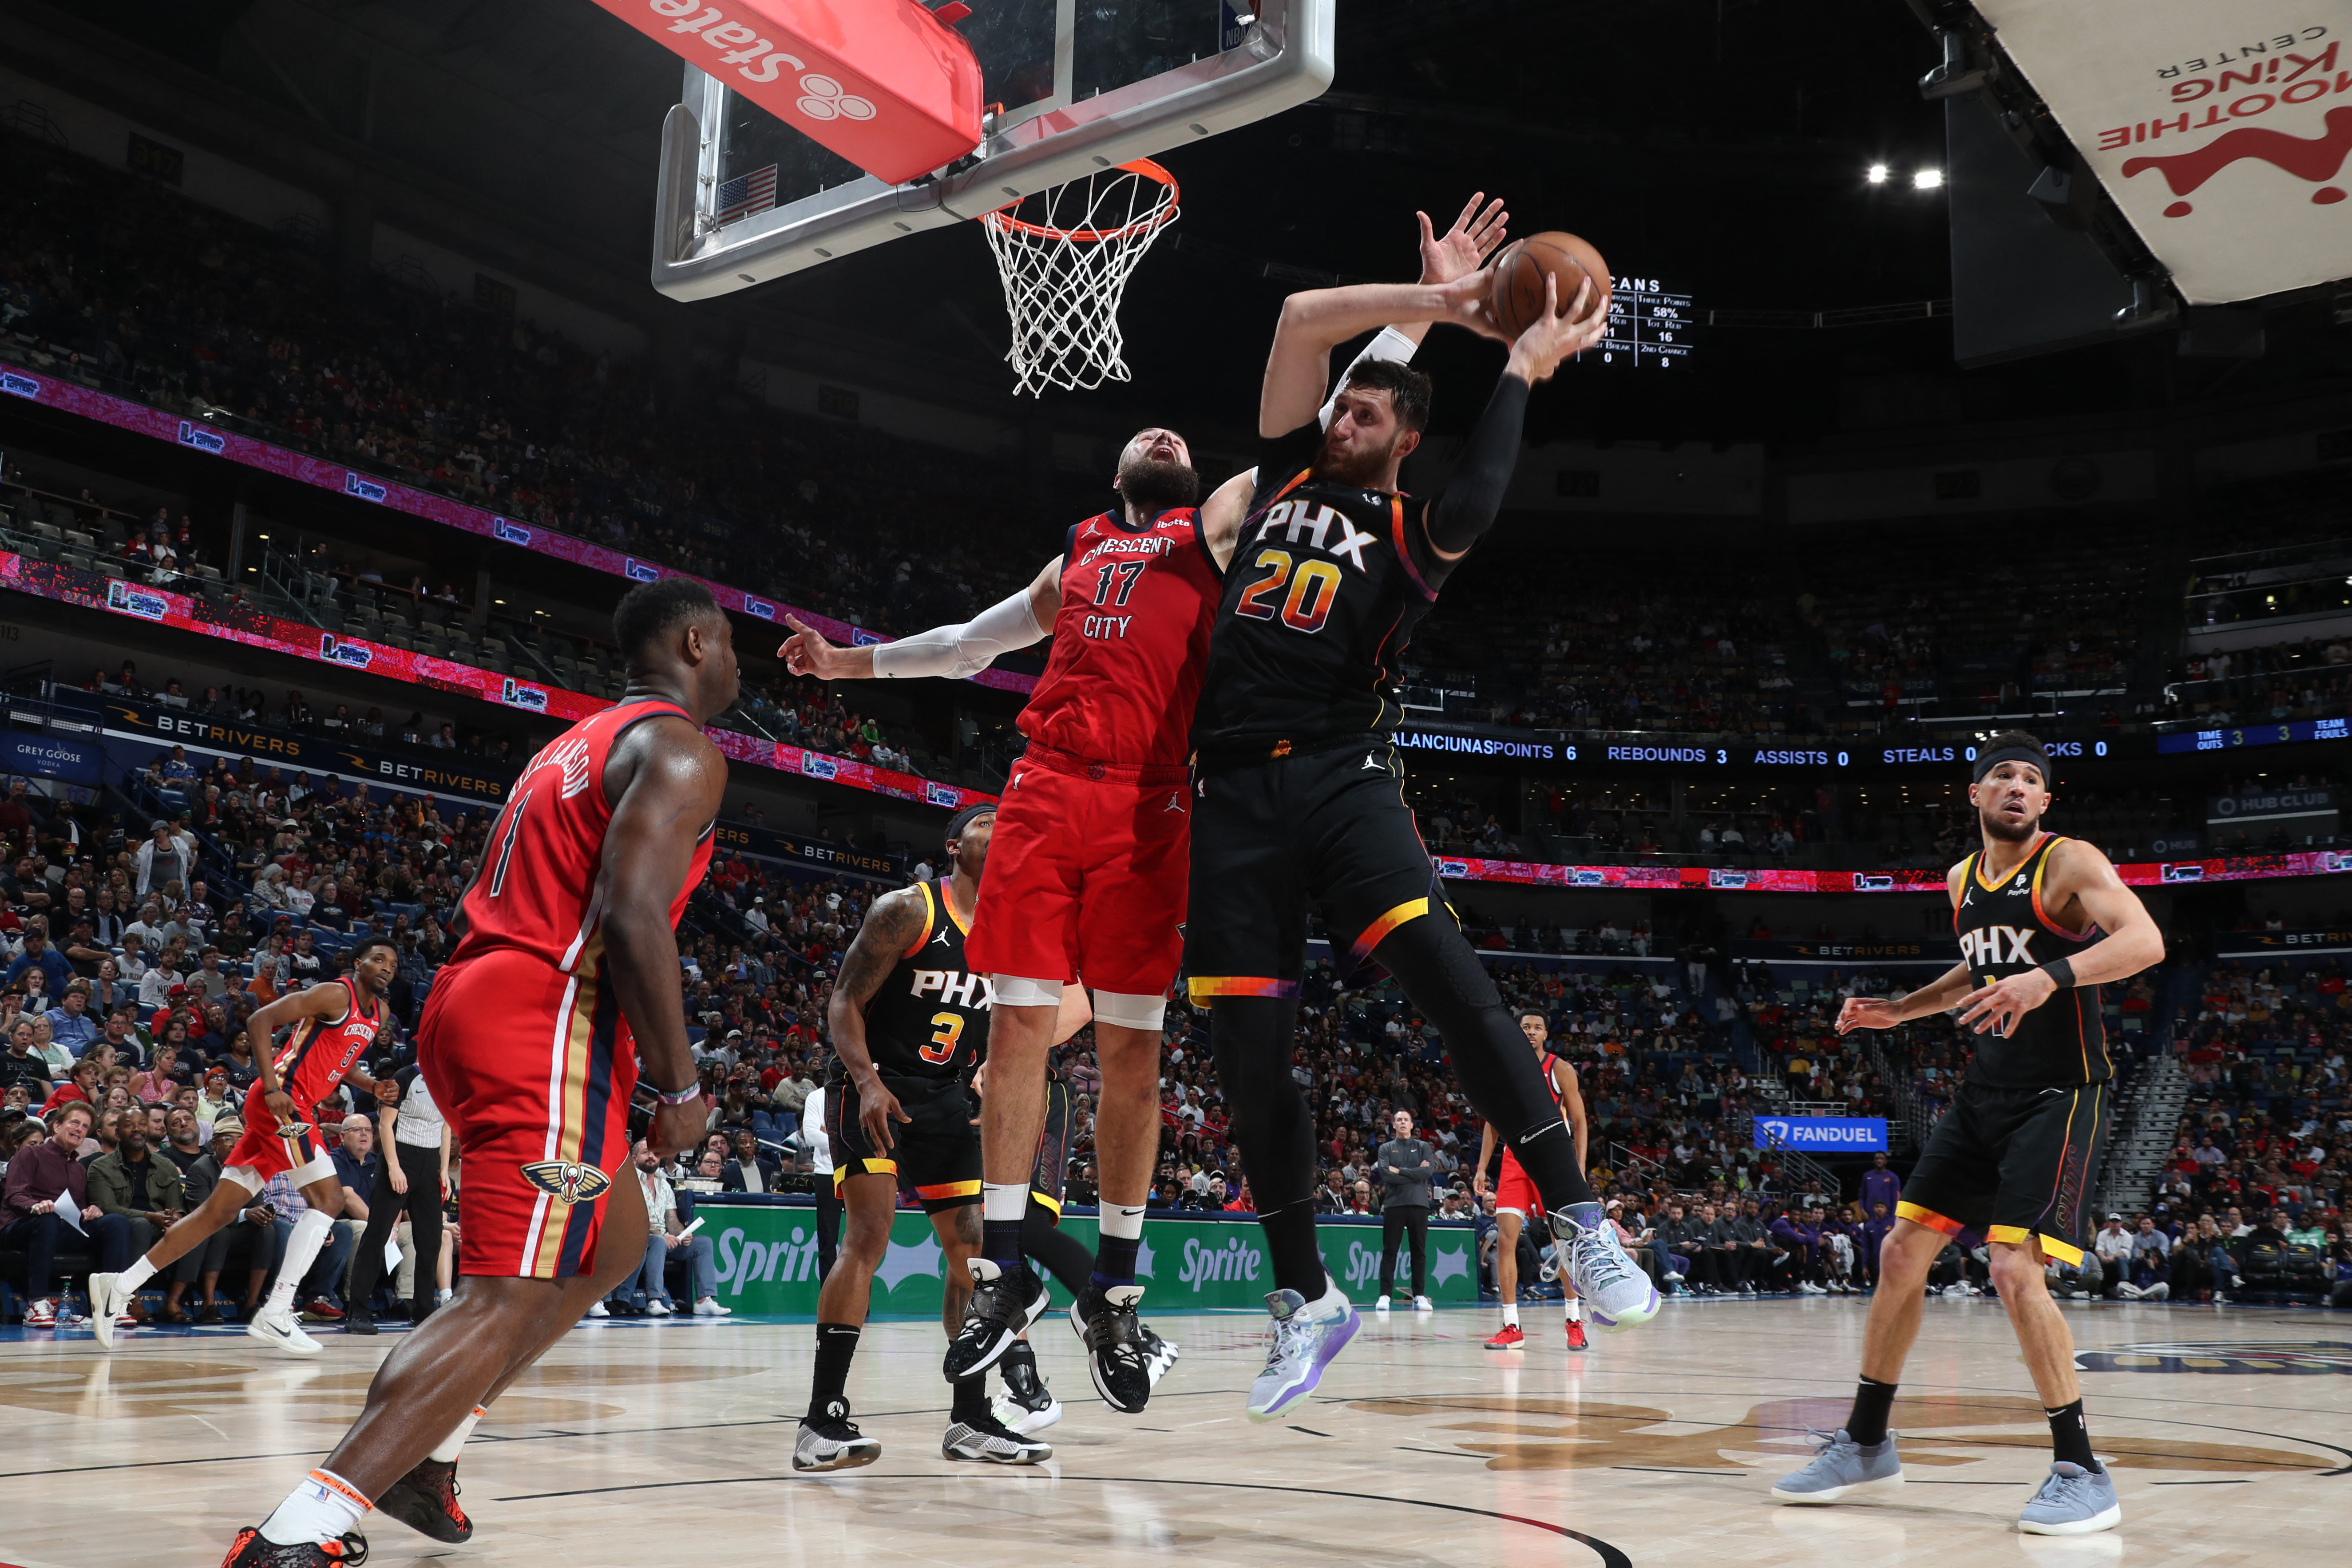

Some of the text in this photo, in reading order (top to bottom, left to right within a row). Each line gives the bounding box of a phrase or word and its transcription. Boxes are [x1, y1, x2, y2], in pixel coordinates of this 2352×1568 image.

[650, 0, 806, 83] State
[2158, 26, 2328, 79] CENTER
[1653, 307, 1678, 319] 58%
[1665, 321, 1682, 329] REB
[1659, 332, 1673, 343] 16
[1605, 341, 1631, 351] BREAK
[1604, 352, 1612, 363] 0
[1661, 357, 1670, 368] 8
[643, 501, 662, 517] 317
[704, 523, 721, 536] 318
[1157, 518, 1191, 529] ibotta
[1255, 500, 1378, 572] PHX
[1080, 536, 1176, 567] CRESCENT
[1093, 560, 1146, 606] 17
[1235, 549, 1342, 634] 20
[1084, 615, 1132, 640] CITY
[1445, 672, 1461, 682] 321
[2315, 718, 2345, 729] TEAM
[157, 715, 300, 756] BETRIVERS
[2197, 730, 2222, 740] TIME
[2233, 730, 2244, 745] 3
[2279, 725, 2291, 741] 3
[2314, 729, 2348, 740] FOULS
[1493, 741, 1553, 759] POINTS
[1567, 746, 1576, 760] 6
[2095, 742, 2107, 756] 0
[2197, 740, 2223, 750] OUTS
[17, 744, 81, 763] GREY GOOSE
[1608, 746, 1727, 764] REBOUNDS 3
[1754, 750, 1849, 766] ASSISTS 0
[1883, 747, 1976, 763] STEALS 0
[37, 759, 60, 768] VODKA
[380, 760, 501, 795] BETRIVERS
[2241, 792, 2329, 811] HUB CLUB
[489, 788, 534, 898] 1
[805, 846, 890, 872] BETRIVERS
[1820, 945, 1920, 956] BETRIVERS
[1959, 926, 2039, 971] PHX
[919, 1012, 965, 1065] 3
[341, 1042, 360, 1068] 5
[1793, 1128, 1878, 1142] FANDUEL
[714, 1226, 822, 1295] Sprit
[1179, 1237, 1260, 1292] Sprite
